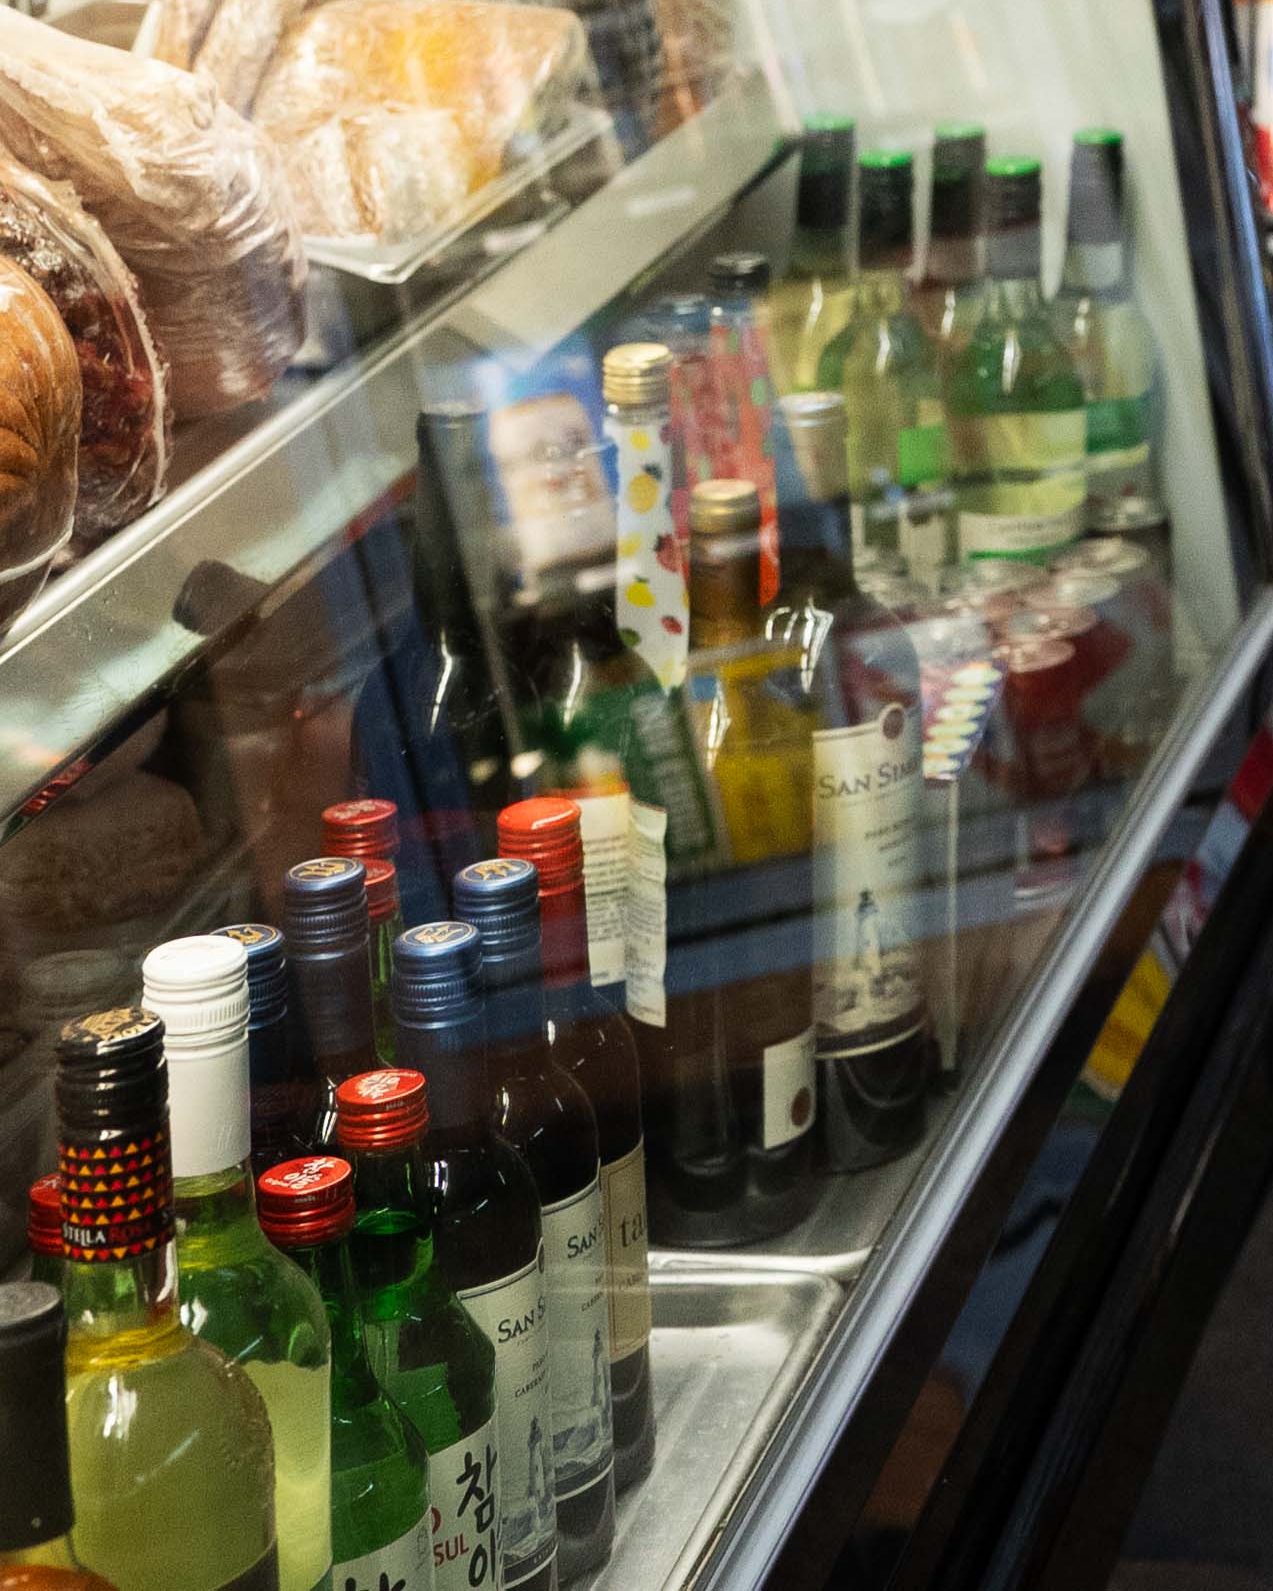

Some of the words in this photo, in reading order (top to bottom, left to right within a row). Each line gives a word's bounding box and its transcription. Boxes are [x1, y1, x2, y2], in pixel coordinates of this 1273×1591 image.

[817, 772, 871, 801] SAN
[61, 1221, 106, 1247] STELLA
[566, 1225, 599, 1260] SAN
[497, 1309, 535, 1344] SAN
